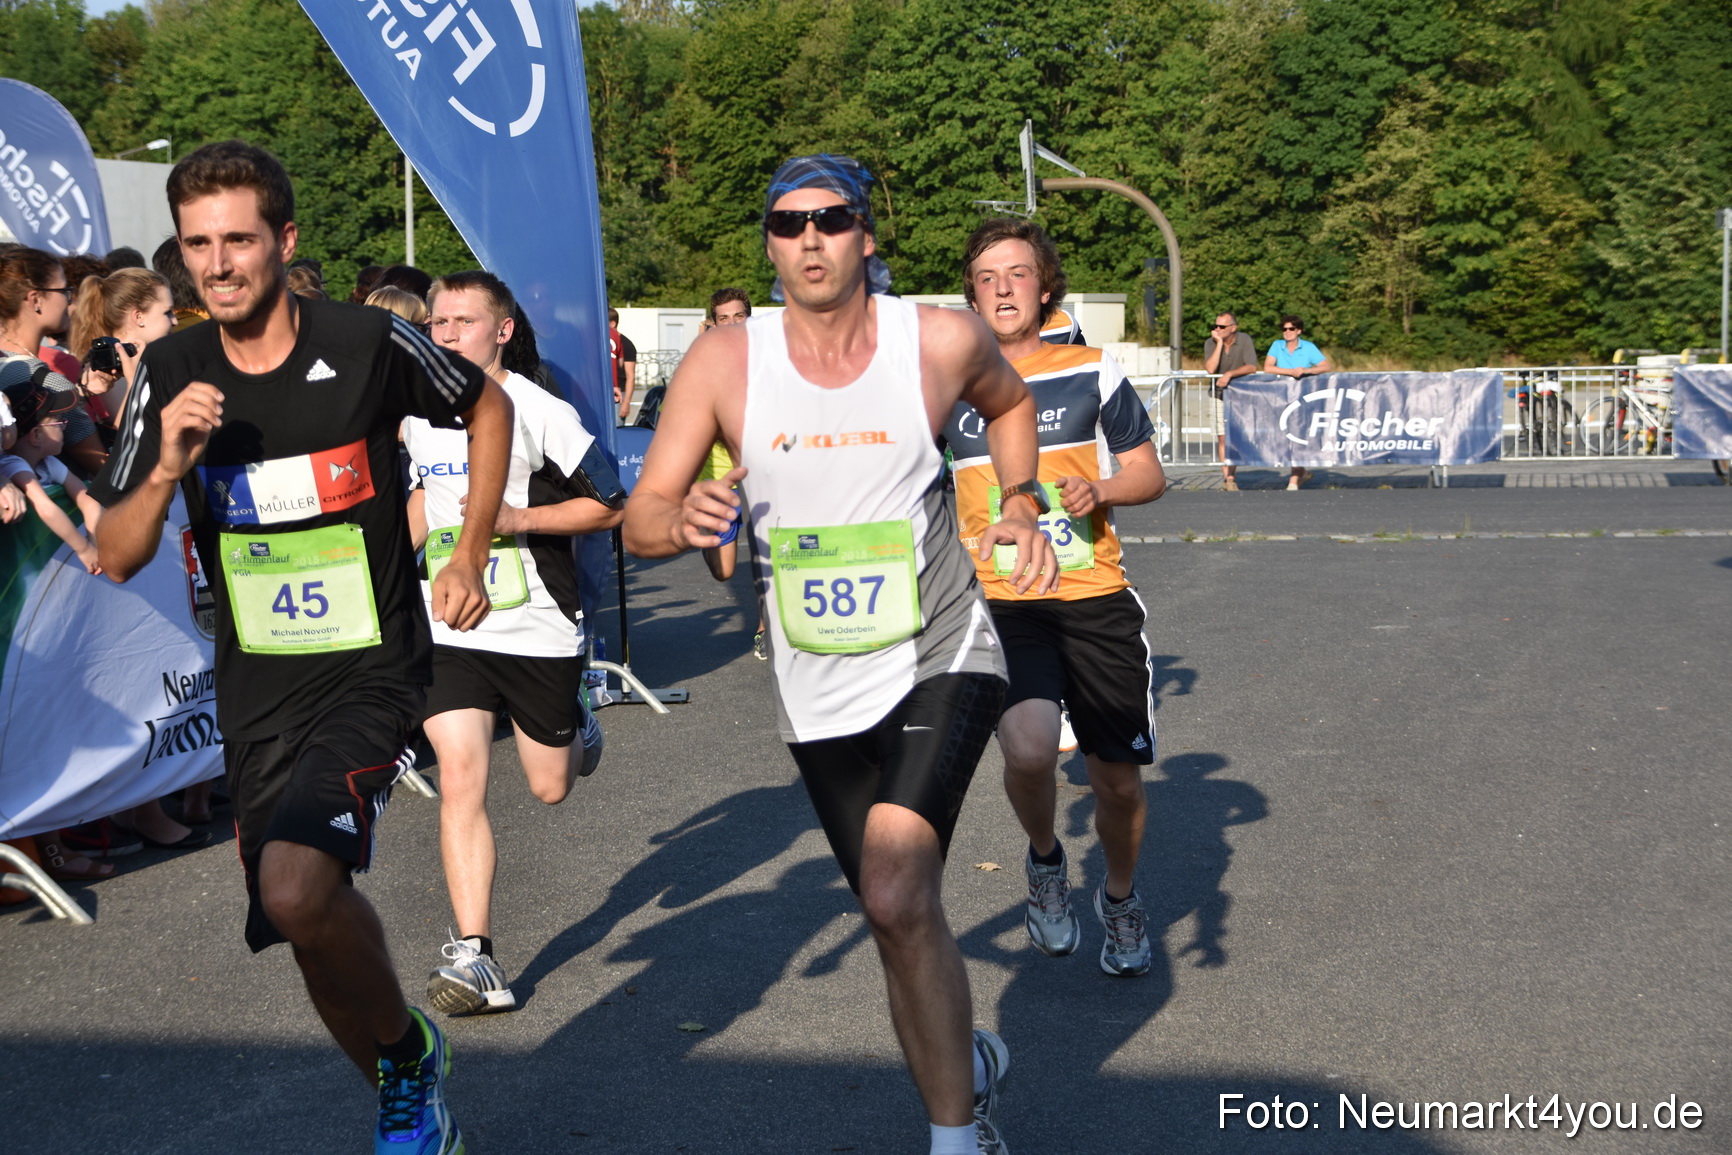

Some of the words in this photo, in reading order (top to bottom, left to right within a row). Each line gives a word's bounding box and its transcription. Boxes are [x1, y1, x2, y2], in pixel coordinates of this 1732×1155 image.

[1308, 411, 1445, 438] Fischer
[802, 430, 897, 449] KLEBL
[1320, 440, 1434, 452] AUTOMOBILE
[259, 495, 316, 514] MÜLLER
[243, 553, 291, 564] firmenlauf
[790, 546, 839, 558] firmenlauf
[488, 556, 500, 585] 7
[272, 581, 329, 620] 45
[803, 575, 885, 618] 587
[271, 629, 303, 637] Michael
[304, 626, 340, 635] Novotny
[817, 626, 836, 635] Uwe
[836, 625, 876, 634] Oderbein
[330, 820, 359, 835] adidas
